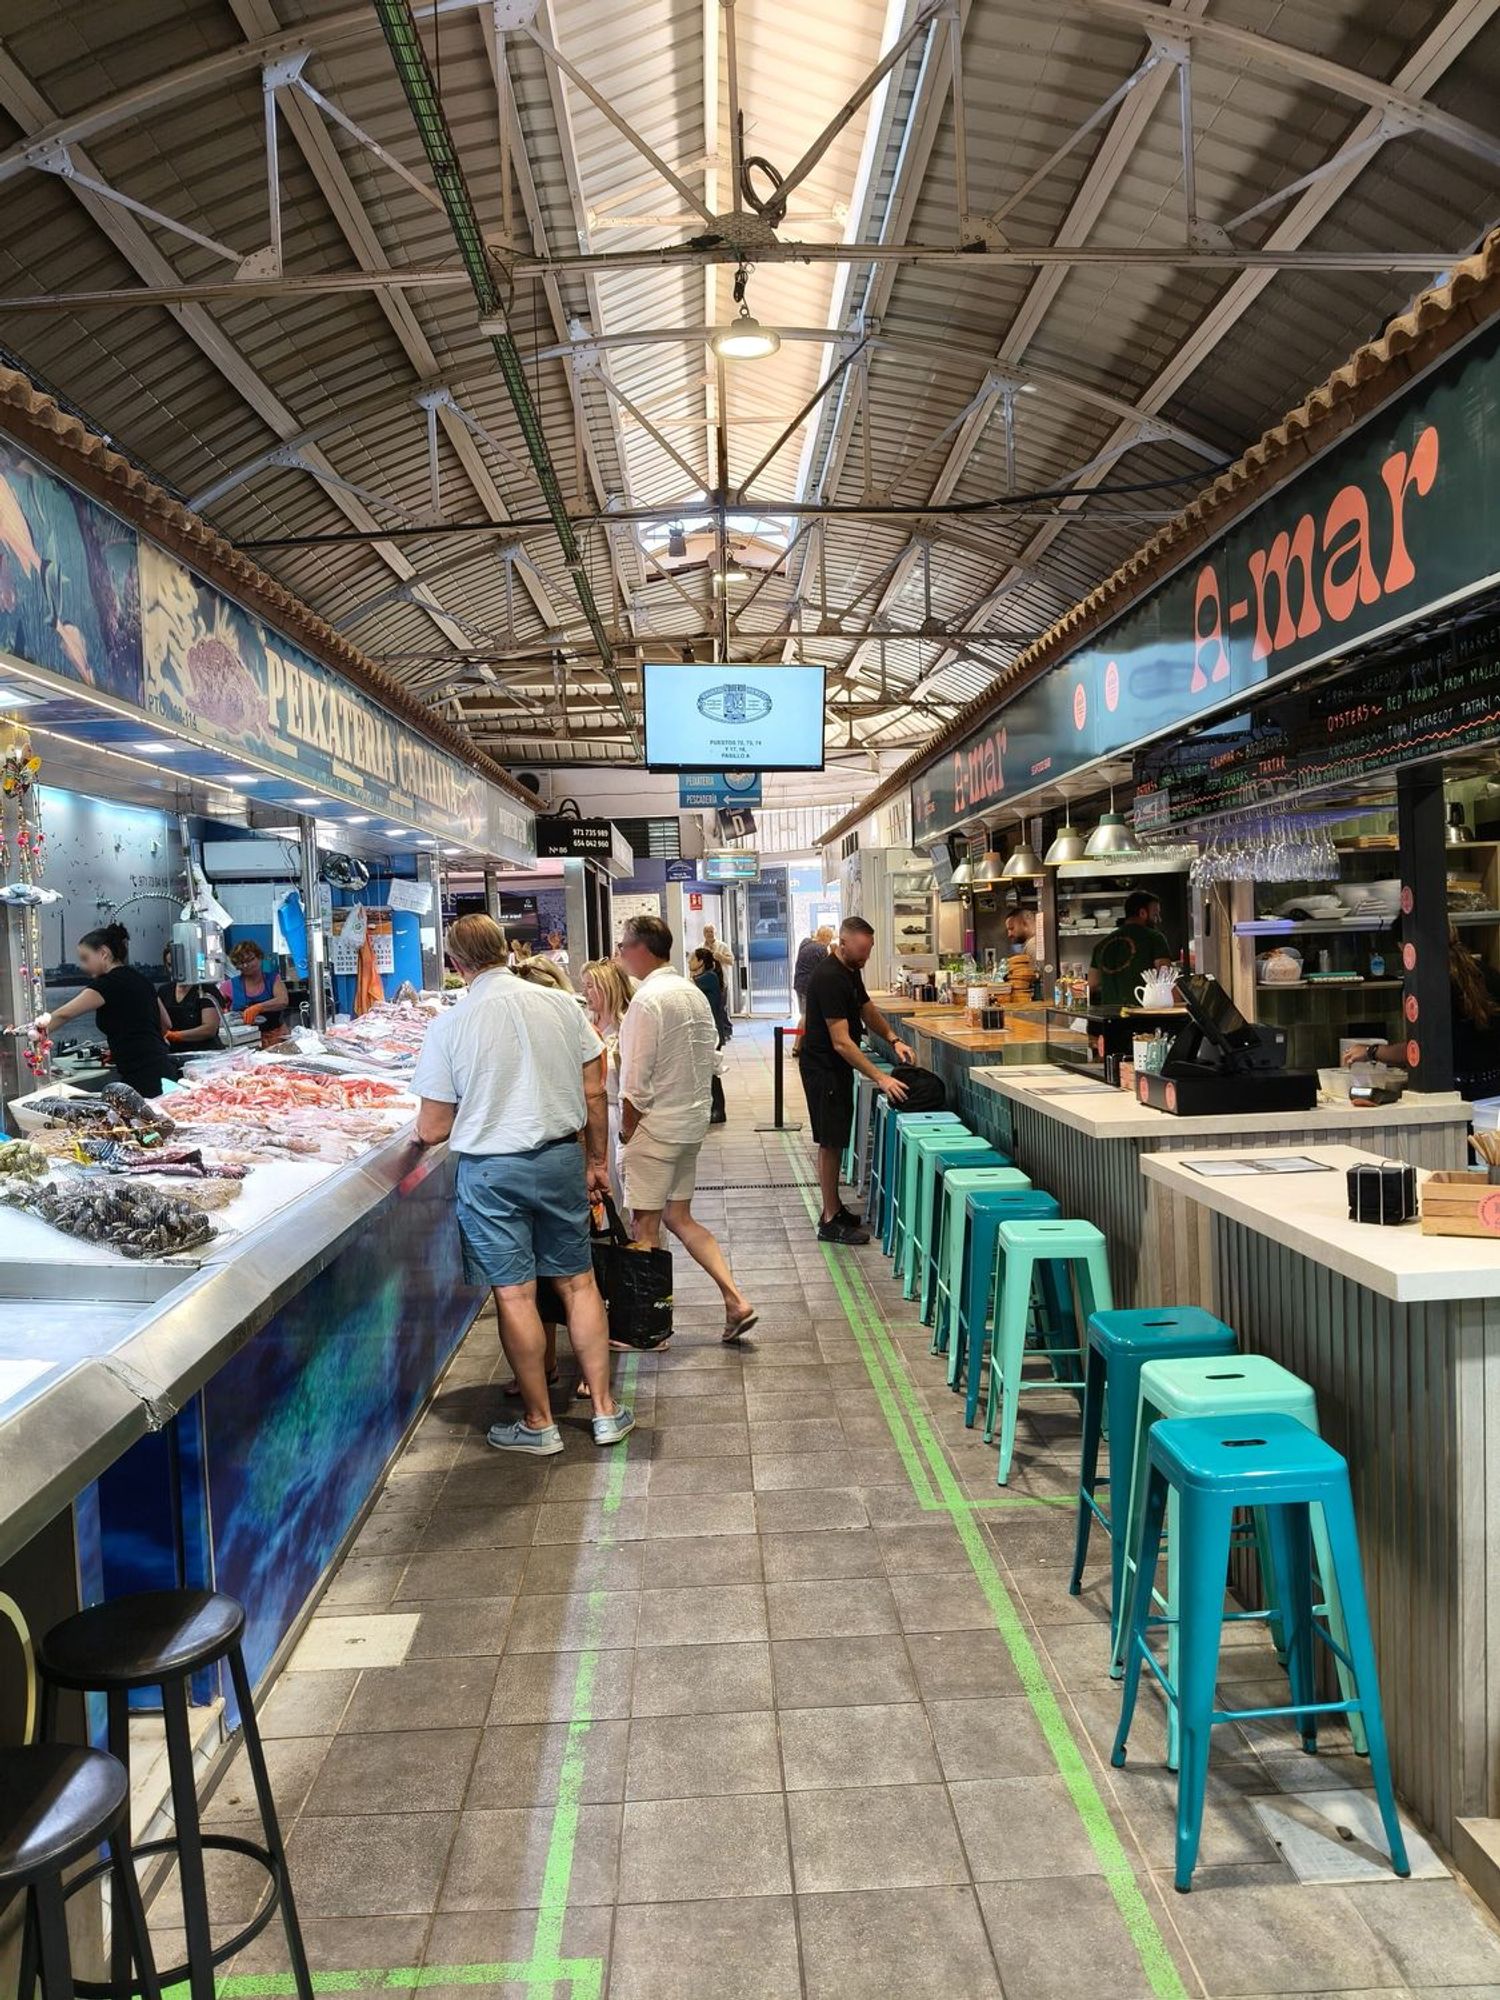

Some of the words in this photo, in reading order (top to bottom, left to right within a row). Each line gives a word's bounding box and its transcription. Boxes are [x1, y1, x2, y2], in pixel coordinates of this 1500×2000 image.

[1190, 426, 1440, 694] A-mar
[264, 646, 396, 784] PEIXATERIA
[399, 735, 459, 812] CATALINA
[1327, 703, 1370, 732] OYSTERS
[1386, 695, 1403, 713] RED
[1407, 682, 1439, 704] PRAWNS
[1443, 675, 1465, 692] FROM
[1461, 694, 1491, 716] TATAKI
[954, 727, 1007, 813] A-mar
[573, 828, 584, 836] 971
[573, 839, 585, 847] 654
